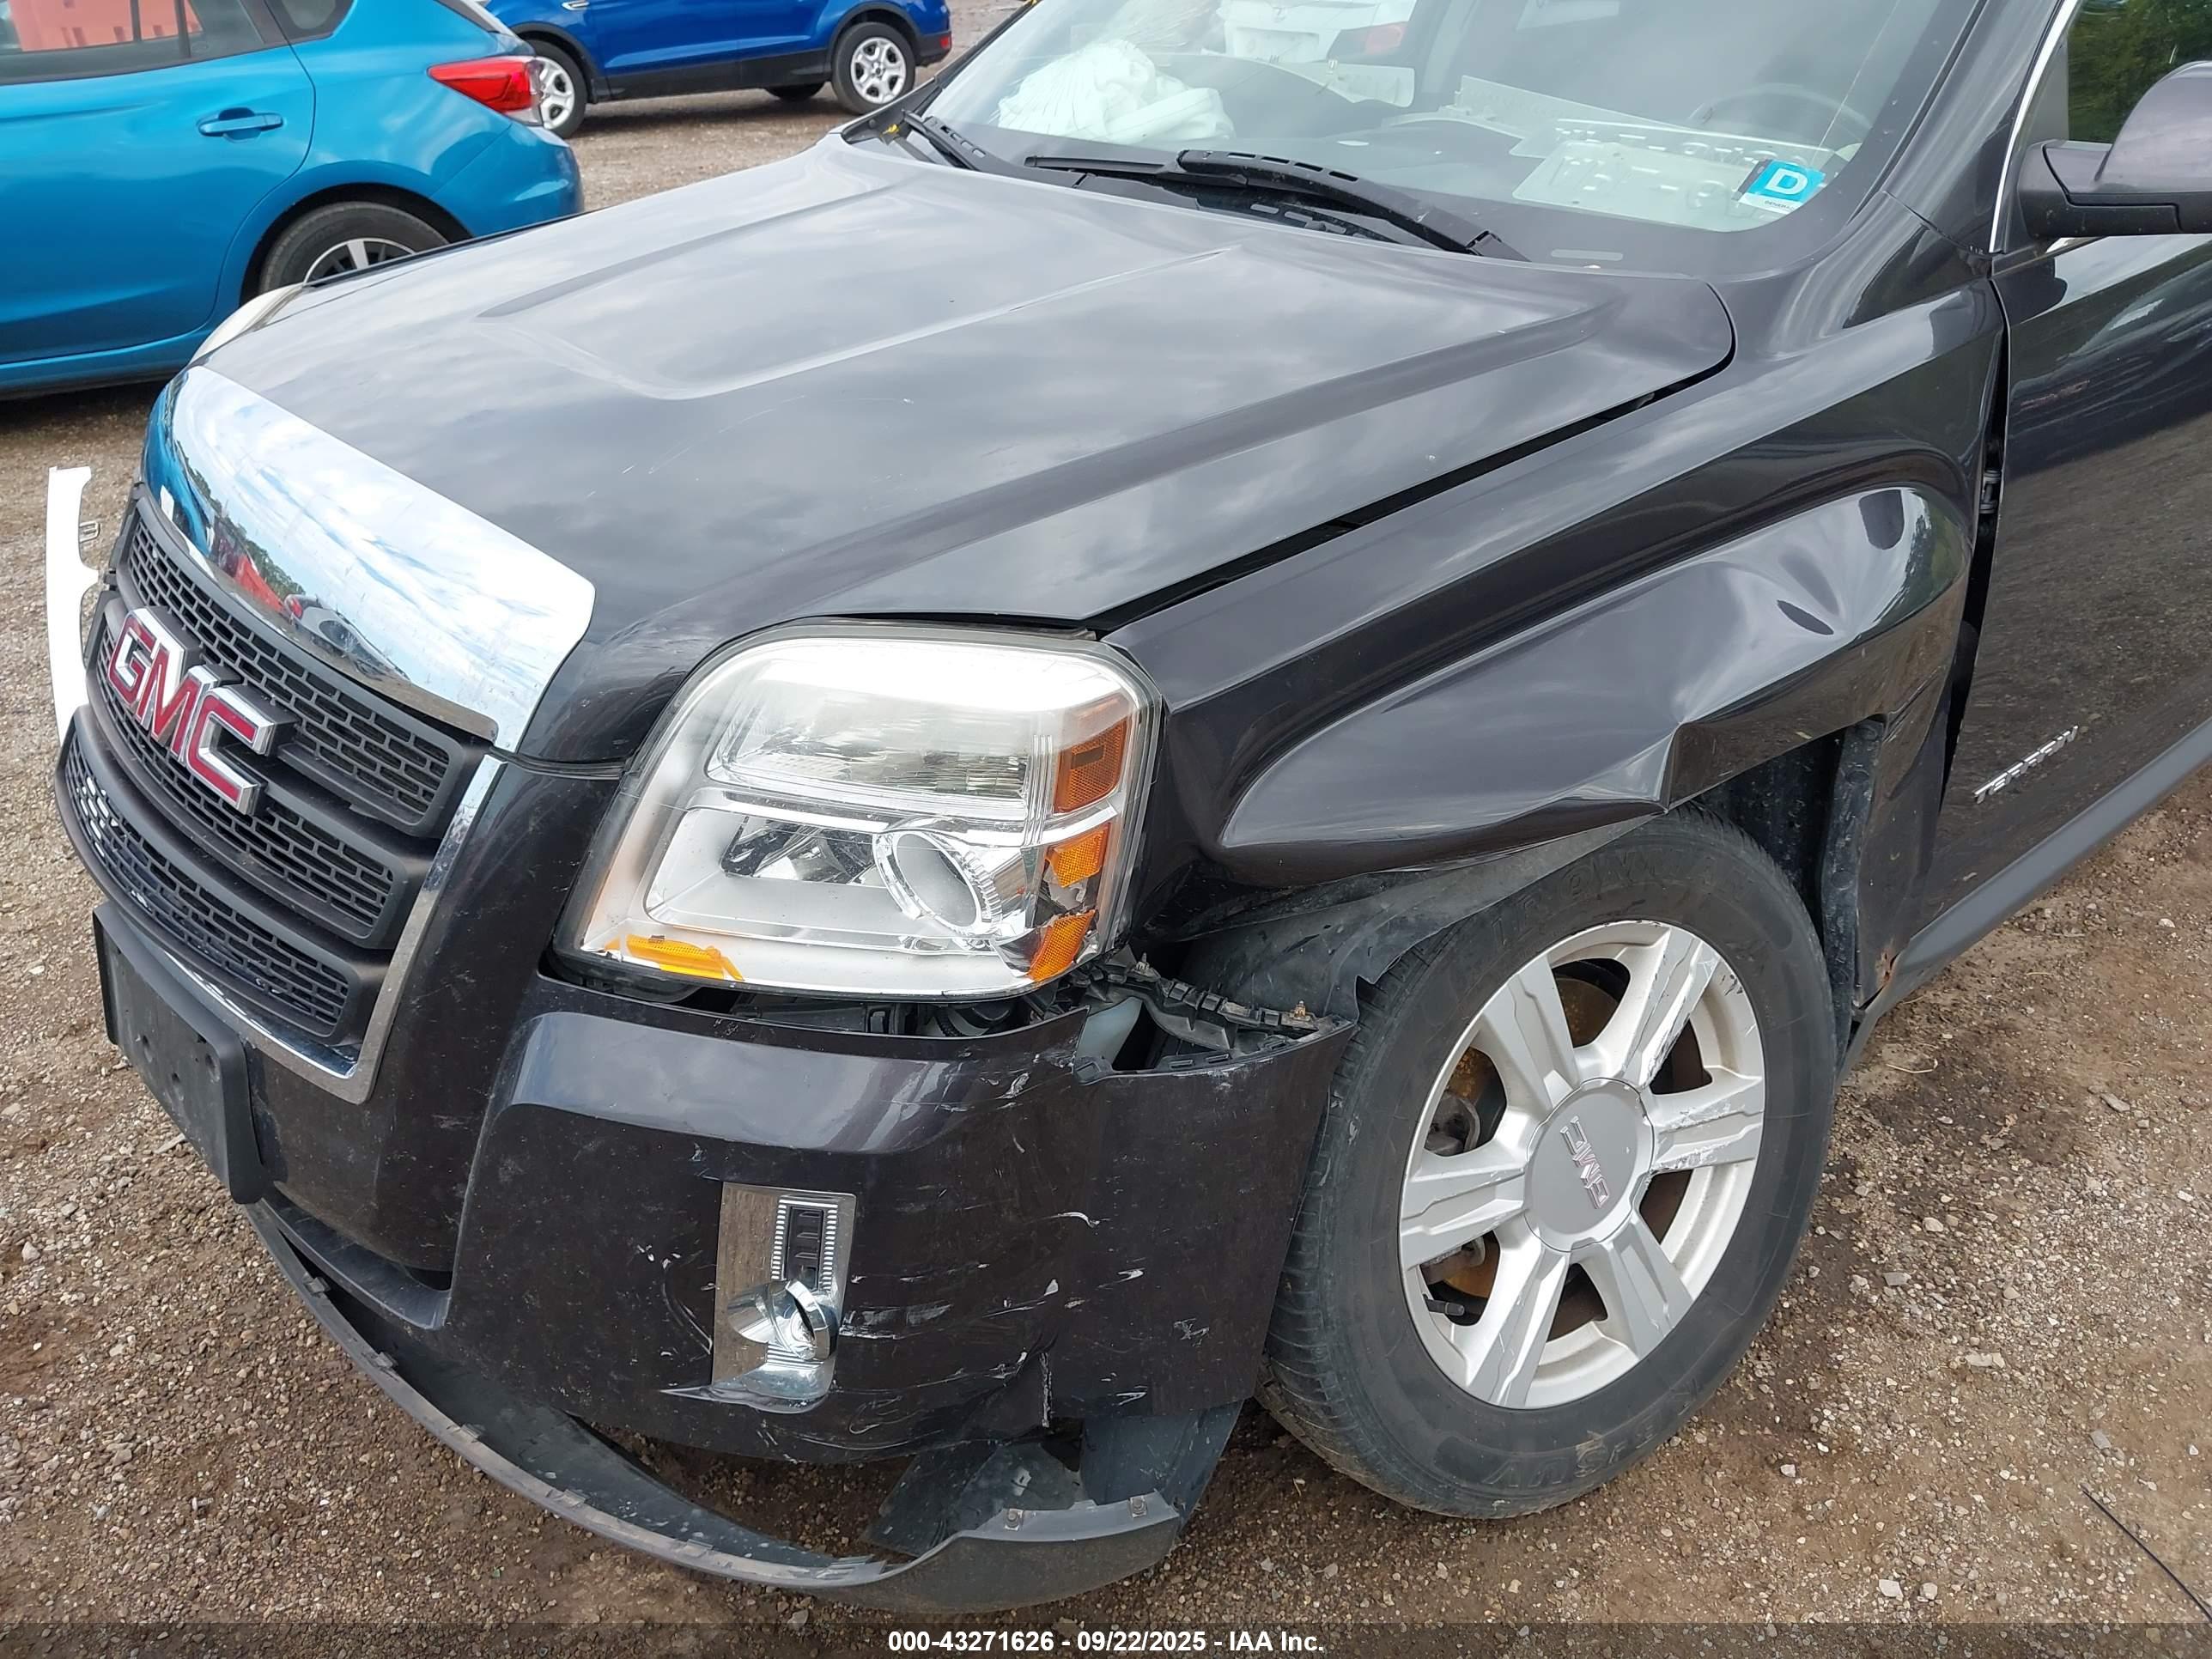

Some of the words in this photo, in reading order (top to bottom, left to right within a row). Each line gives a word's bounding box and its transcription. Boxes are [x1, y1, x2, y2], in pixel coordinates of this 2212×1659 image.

[1765, 168, 1808, 195] D
[108, 608, 275, 814] GMC
[1974, 725, 2078, 805] TERRAIN
[1559, 1115, 1610, 1209] GMC
